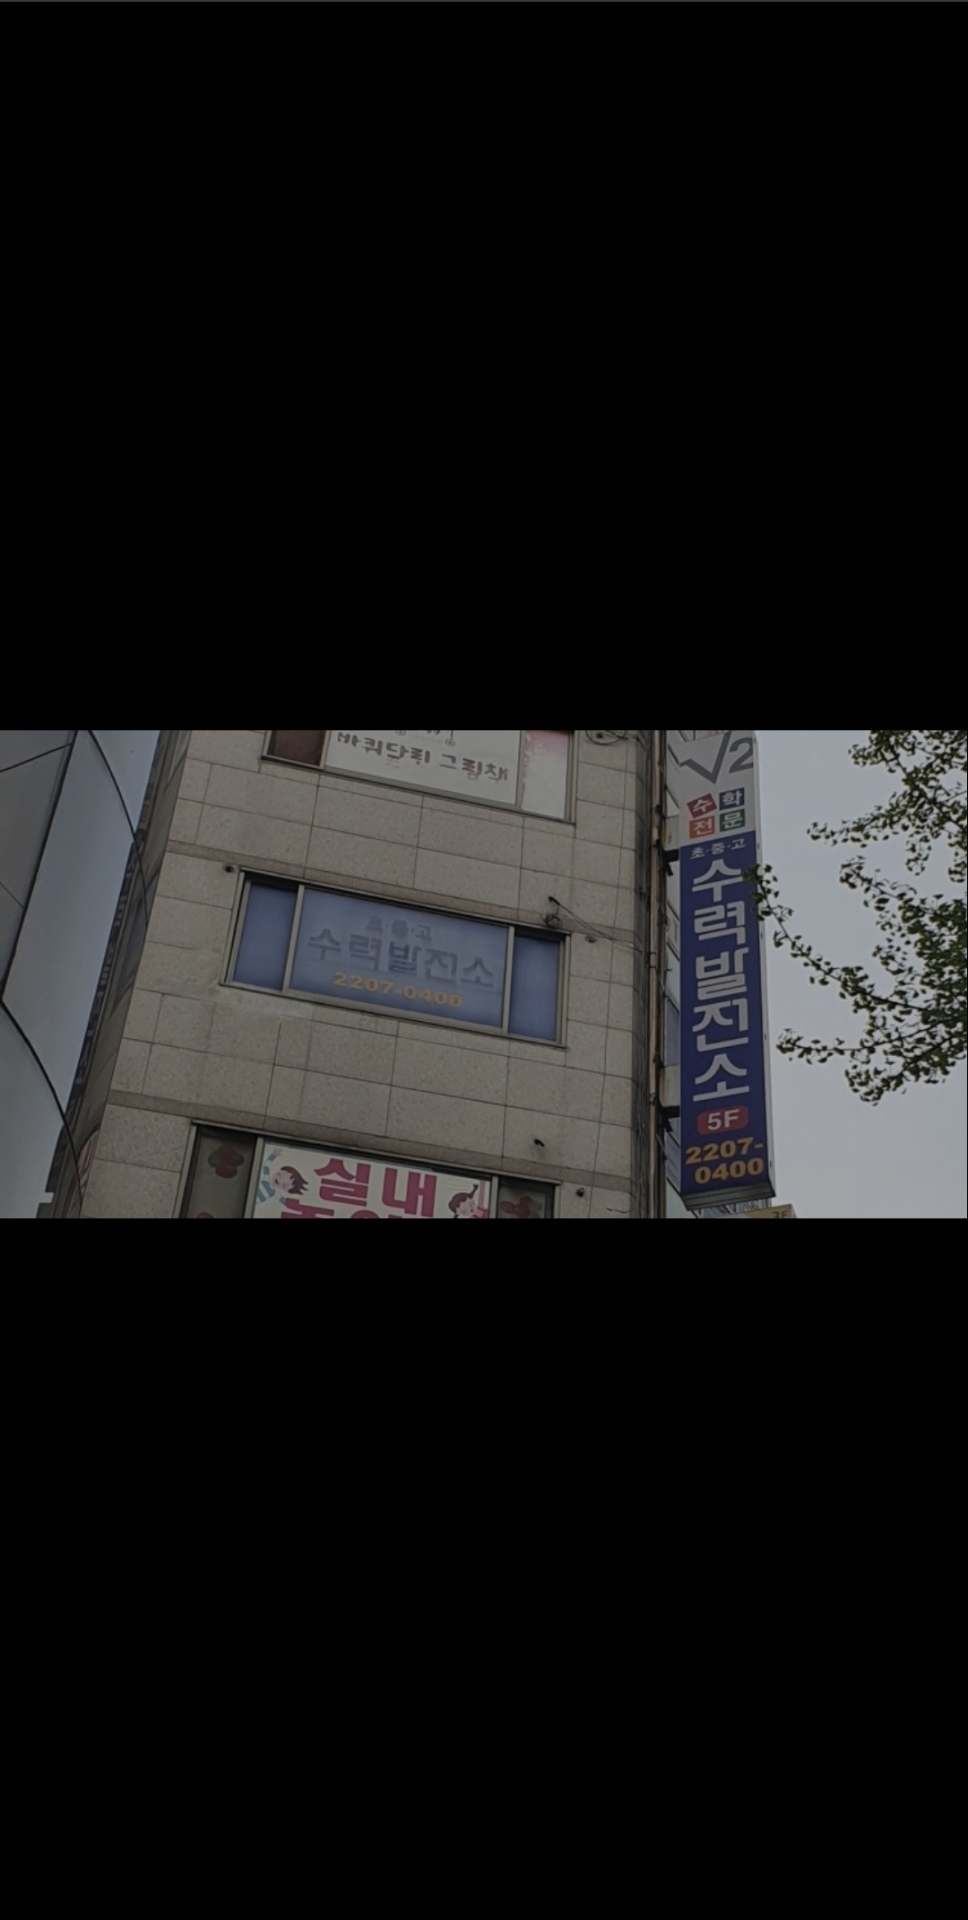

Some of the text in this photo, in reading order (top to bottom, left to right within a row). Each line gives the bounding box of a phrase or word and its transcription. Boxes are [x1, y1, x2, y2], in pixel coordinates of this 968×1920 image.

[333, 972, 463, 1007] 2207-0400
[707, 1109, 740, 1131] 5F
[685, 1137, 764, 1165] 2207-
[694, 1158, 764, 1185] 0400
[313, 1158, 437, 1218] 실내
